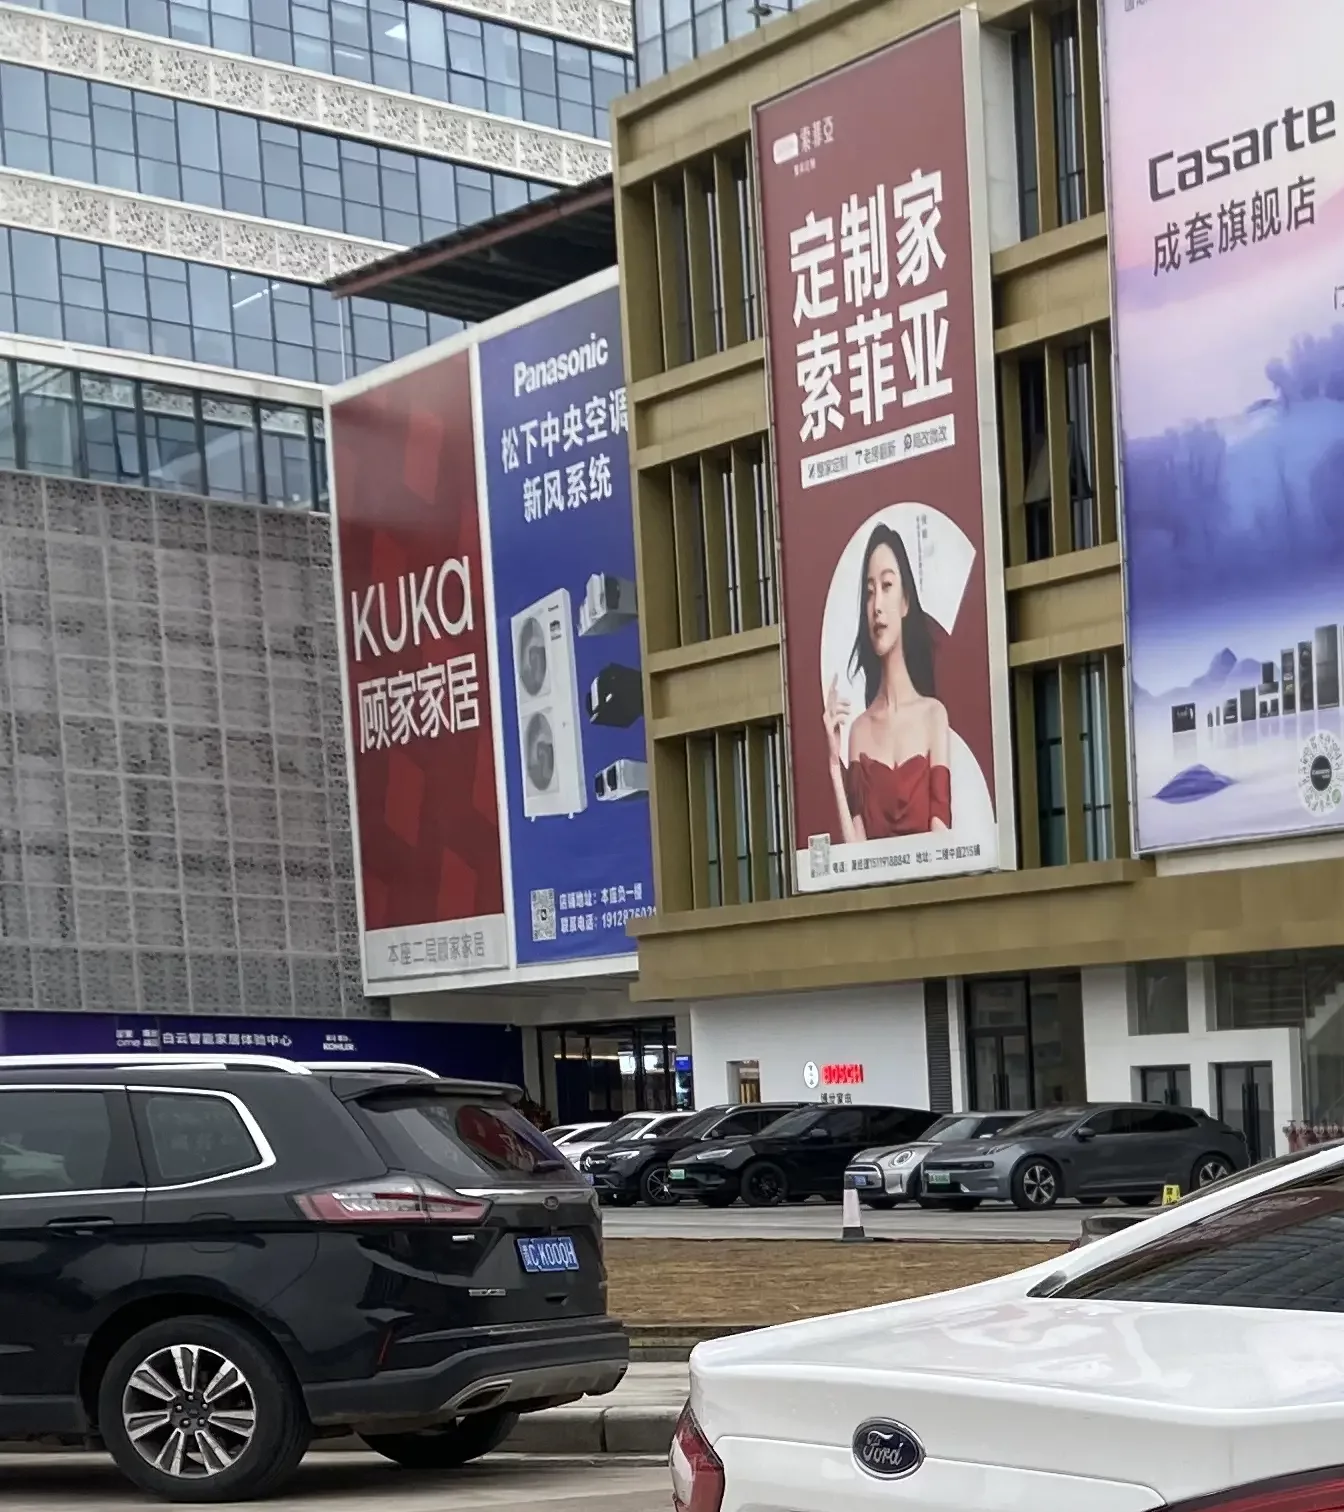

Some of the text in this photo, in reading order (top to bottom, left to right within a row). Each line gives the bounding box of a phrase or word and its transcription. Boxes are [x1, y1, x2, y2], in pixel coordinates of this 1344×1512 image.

[1148, 99, 1336, 202] Casarte
[789, 167, 949, 329] 定制家
[1153, 175, 1316, 277] 成套旗舰店
[513, 332, 609, 397] Panasonic
[794, 290, 954, 443] 索菲亚
[501, 387, 629, 474] 松下中央空调
[522, 453, 613, 523] 新风系统
[358, 653, 481, 755] 顾家家居
[822, 1064, 864, 1084] BOSCH
[863, 1430, 904, 1466] Ford
